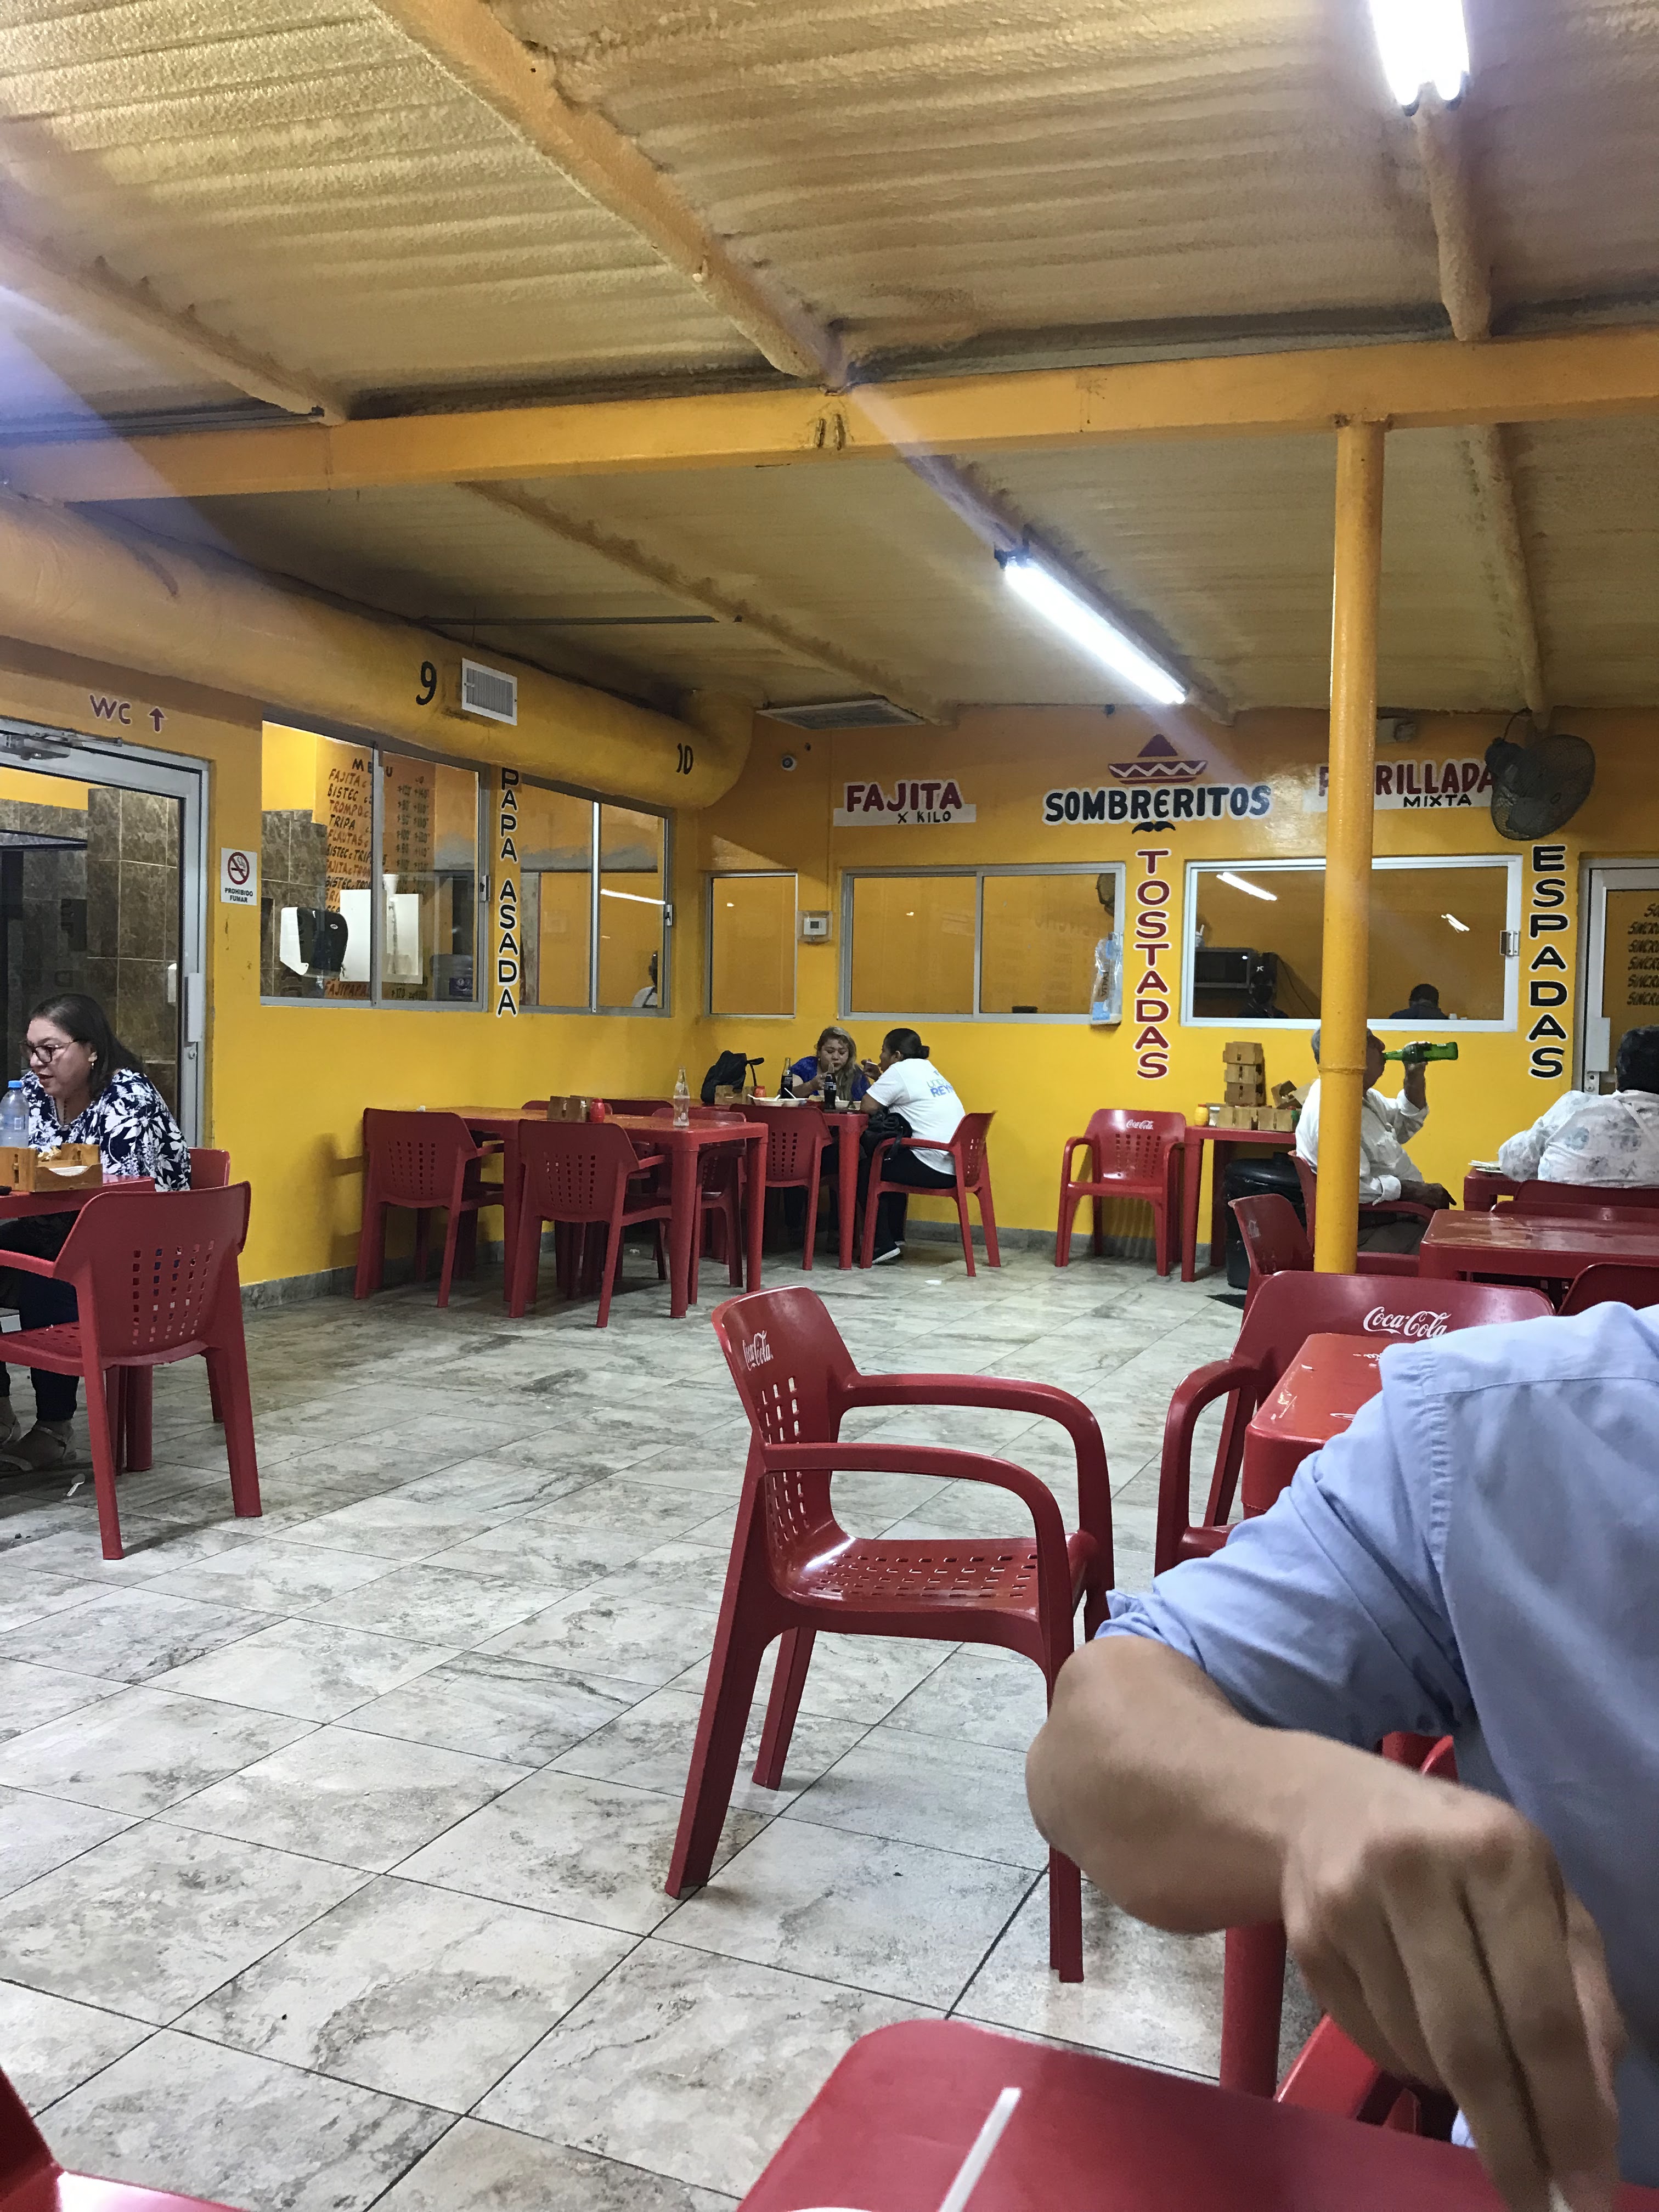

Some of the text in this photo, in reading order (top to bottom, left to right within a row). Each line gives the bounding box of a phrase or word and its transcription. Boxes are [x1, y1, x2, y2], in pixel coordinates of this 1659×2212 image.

[416, 661, 437, 706] 9
[89, 695, 131, 725] WC
[676, 742, 693, 775] 10
[328, 783, 359, 802] BISTEC
[329, 768, 360, 787] FAJITA
[1319, 763, 1494, 797] PRILLADA
[330, 799, 364, 817] TROMPO
[847, 782, 962, 812] FAJITA
[1046, 785, 1272, 822] SOMBRERITOS
[1403, 793, 1472, 808] MIXTA
[330, 814, 356, 831] TRIPA
[917, 810, 951, 823] KILO
[328, 828, 363, 847] FLAUTAS
[224, 887, 253, 897] PROHIBIDO
[229, 895, 248, 903] FUMAR
[498, 768, 519, 1015] PAPA ASADA
[1135, 850, 1170, 1079] TOSTADAS
[1528, 845, 1568, 1079] ESPADAS
[1363, 1306, 1452, 1338] Coca-Cola
